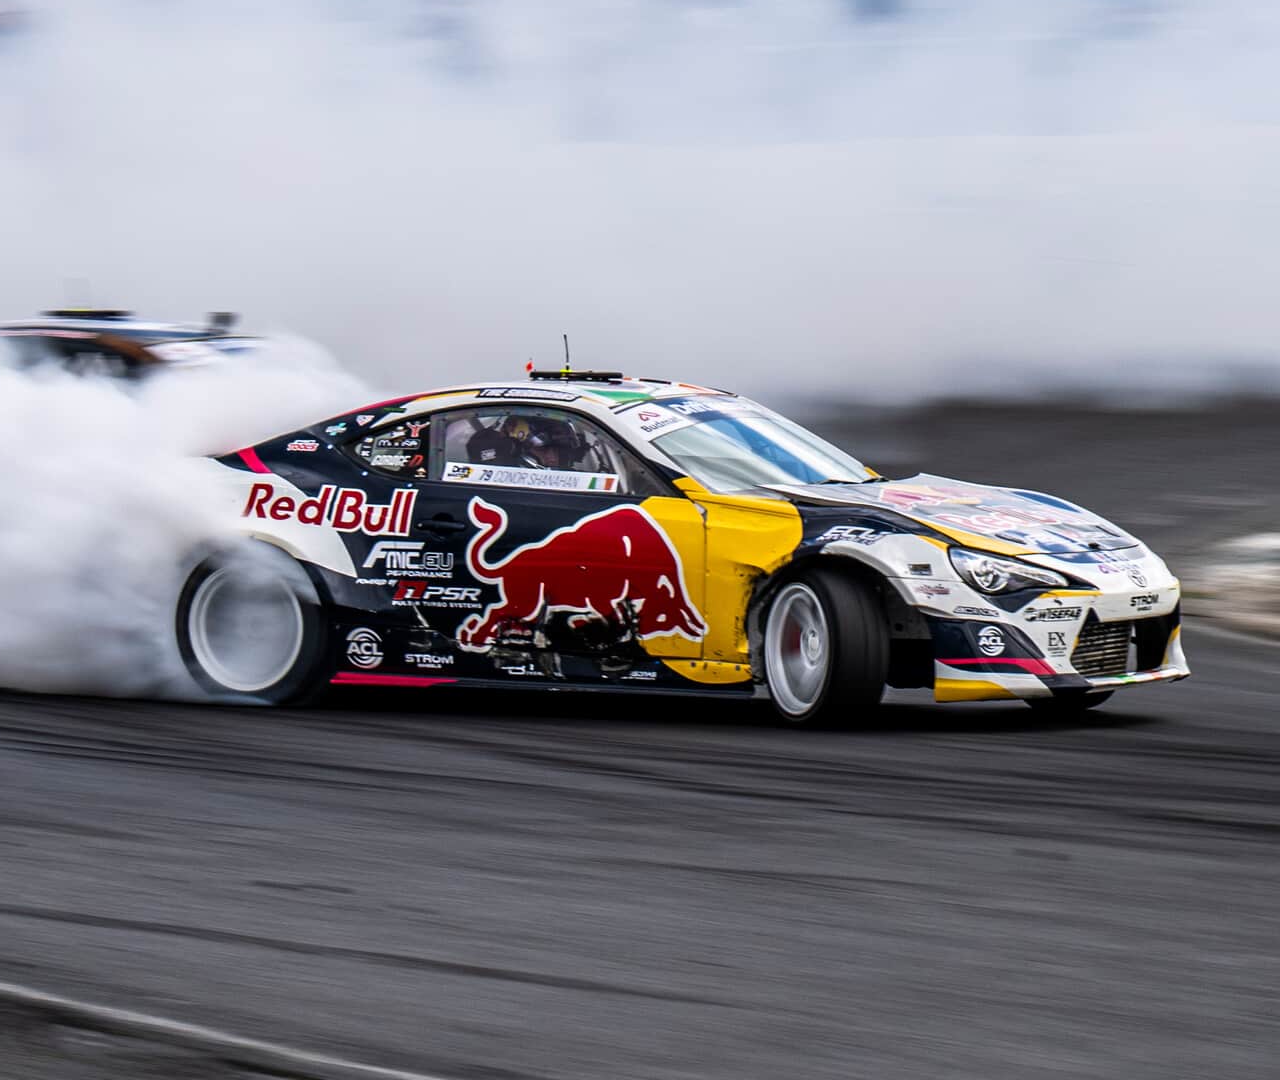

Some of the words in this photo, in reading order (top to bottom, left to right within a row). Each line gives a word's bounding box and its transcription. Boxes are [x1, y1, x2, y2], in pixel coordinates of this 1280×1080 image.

[478, 469, 494, 481] 79
[494, 470, 528, 483] CONOR
[242, 483, 336, 526] Red
[331, 487, 418, 534] Bull
[386, 570, 453, 578] PERFORMANCE
[978, 636, 1005, 646] ACL
[1047, 631, 1066, 646] EX
[346, 641, 385, 656] ACL
